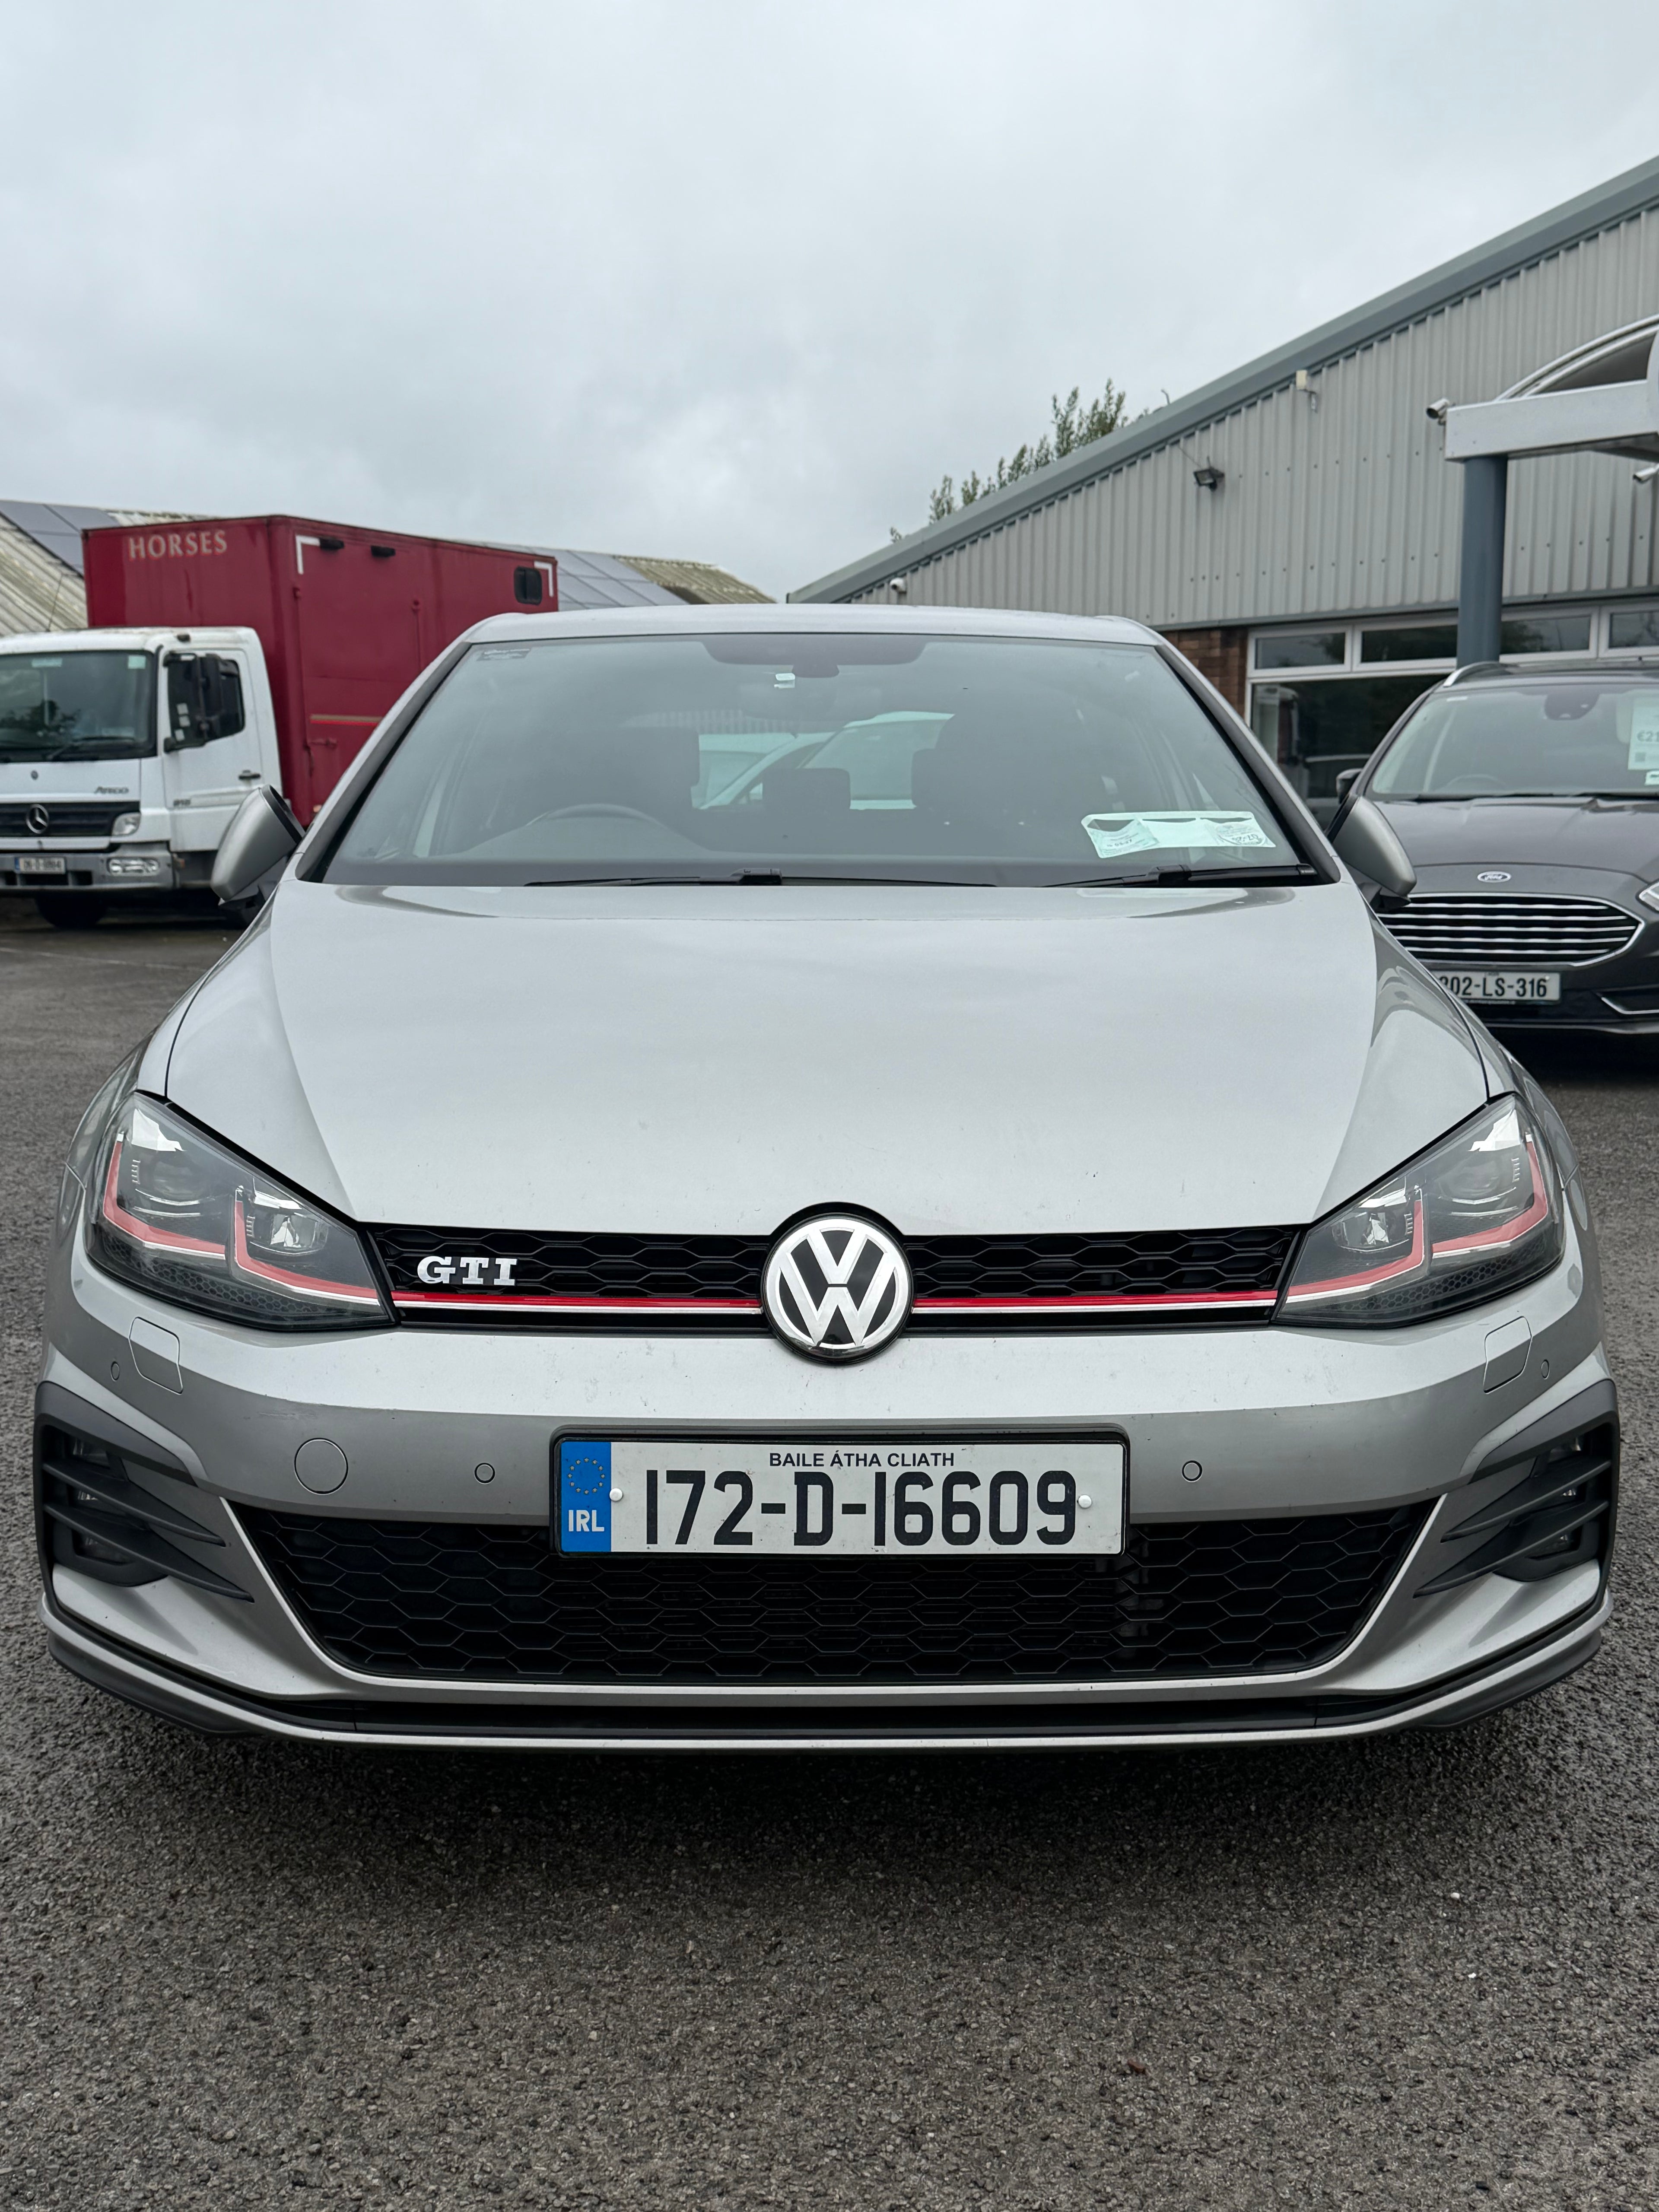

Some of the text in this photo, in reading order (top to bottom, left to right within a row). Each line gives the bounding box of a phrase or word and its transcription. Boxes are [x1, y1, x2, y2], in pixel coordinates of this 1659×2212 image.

[129, 530, 228, 559] HORSES
[417, 1255, 517, 1286] GTI
[769, 1450, 954, 1467] BAILE ÁTHA CLIATH
[568, 1510, 605, 1532] IRL
[646, 1470, 1076, 1546] 172-D-16609
